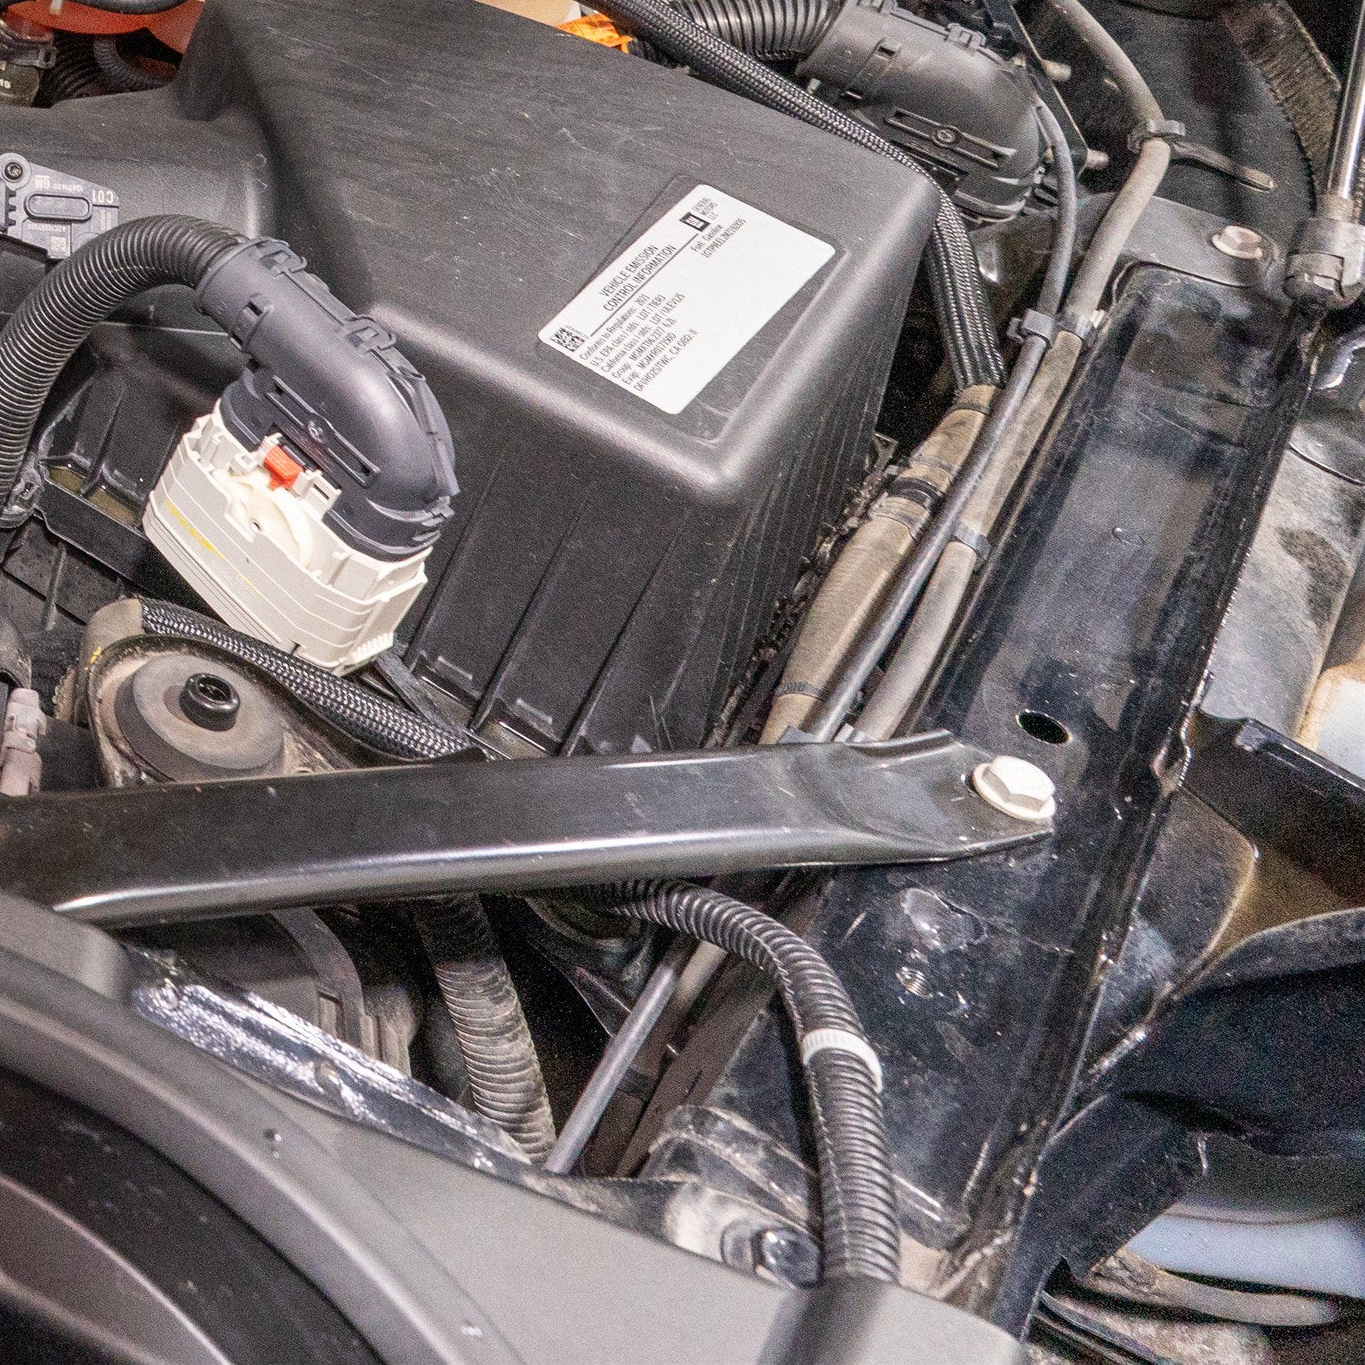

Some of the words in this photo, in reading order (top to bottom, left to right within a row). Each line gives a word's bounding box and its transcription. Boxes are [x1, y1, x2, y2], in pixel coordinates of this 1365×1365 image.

[599, 270, 631, 297] VEHICLE
[625, 244, 659, 273] EMISSION
[603, 280, 639, 312] CONTROL
[632, 244, 677, 284] INFORMATION
[579, 336, 606, 360] Conforms
[601, 330, 611, 338] to
[635, 293, 650, 305] 2021
[600, 344, 615, 357] EPA
[610, 332, 627, 347] class
[637, 308, 651, 320] LDT
[649, 294, 666, 308] TIER3
[601, 348, 628, 373] California
[623, 337, 640, 351] class
[650, 313, 664, 324] LDT
